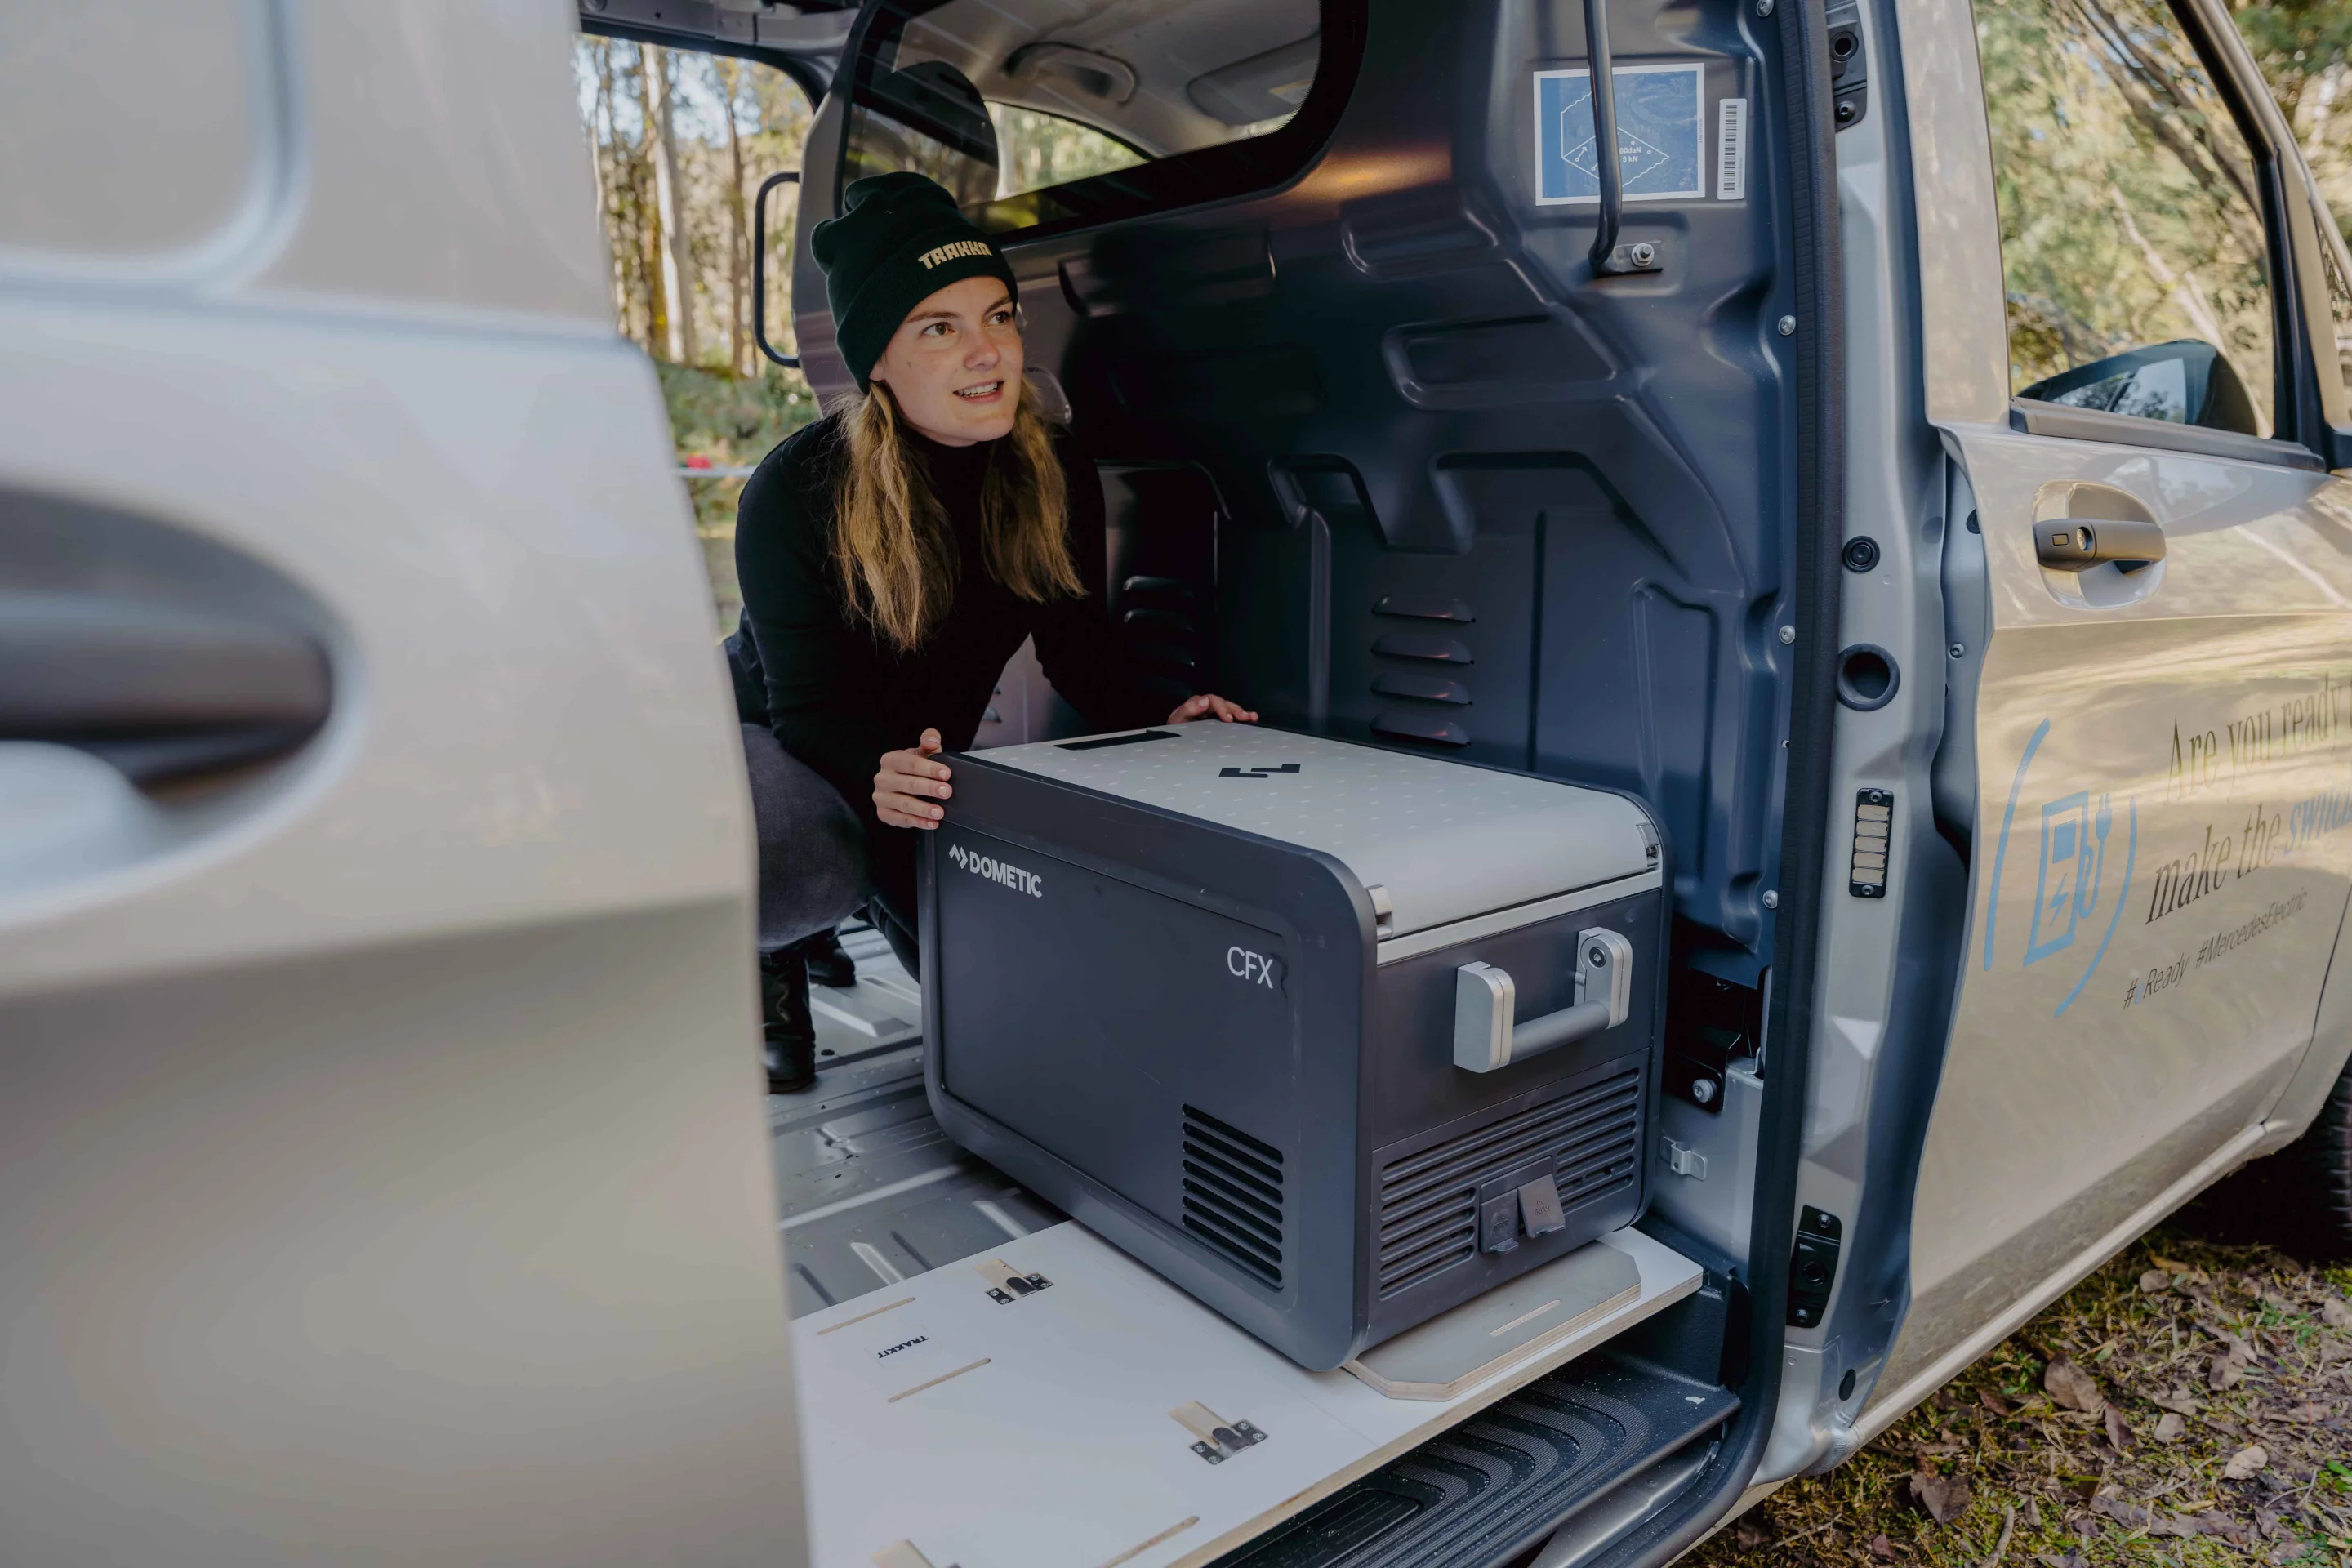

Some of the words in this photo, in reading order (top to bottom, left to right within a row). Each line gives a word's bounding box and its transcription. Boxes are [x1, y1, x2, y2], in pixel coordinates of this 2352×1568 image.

[917, 240, 993, 270] TRAKKA
[2163, 715, 2218, 806] Are
[2226, 708, 2271, 804] you
[2280, 670, 2343, 759] ready
[969, 850, 1043, 898] DOMETIC
[2145, 823, 2232, 925] make
[2237, 801, 2283, 880] the
[1227, 946, 1274, 989] CFX
[2123, 952, 2190, 1010] #eReady
[2195, 887, 2308, 970] #MercedesElectric
[877, 1335, 930, 1359] TRAKKIT
